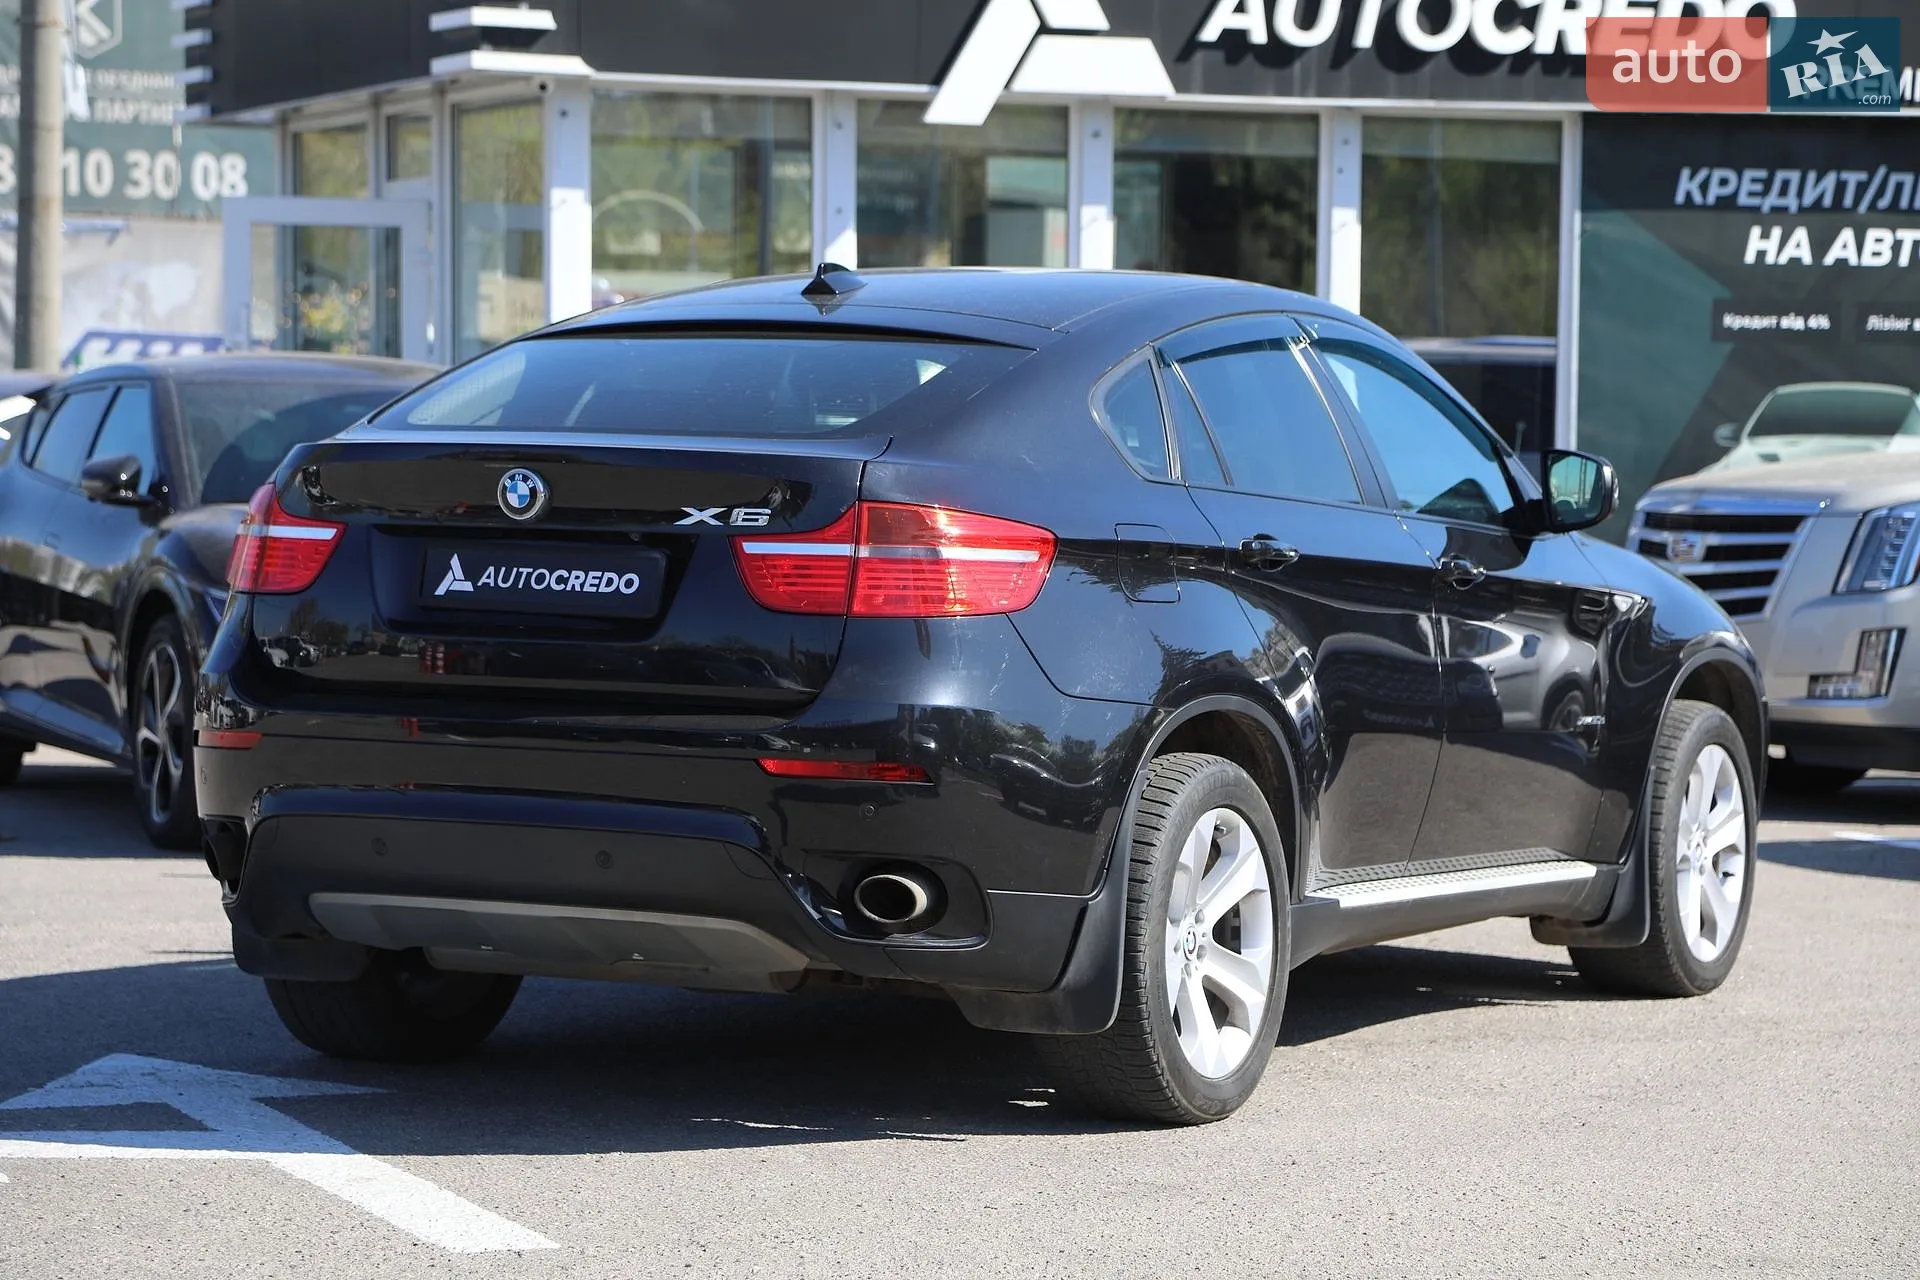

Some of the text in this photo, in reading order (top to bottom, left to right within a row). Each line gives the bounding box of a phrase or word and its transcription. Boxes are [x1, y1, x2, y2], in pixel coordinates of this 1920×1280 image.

[123, 149, 181, 200] 30
[191, 152, 248, 201] 08
[1743, 225, 1920, 267] НА АВТ
[1723, 312, 1778, 330] Кредит
[1779, 312, 1805, 331] від
[504, 473, 535, 488] BMW
[673, 507, 772, 526] X6
[477, 566, 640, 595] AUTOCREDO
